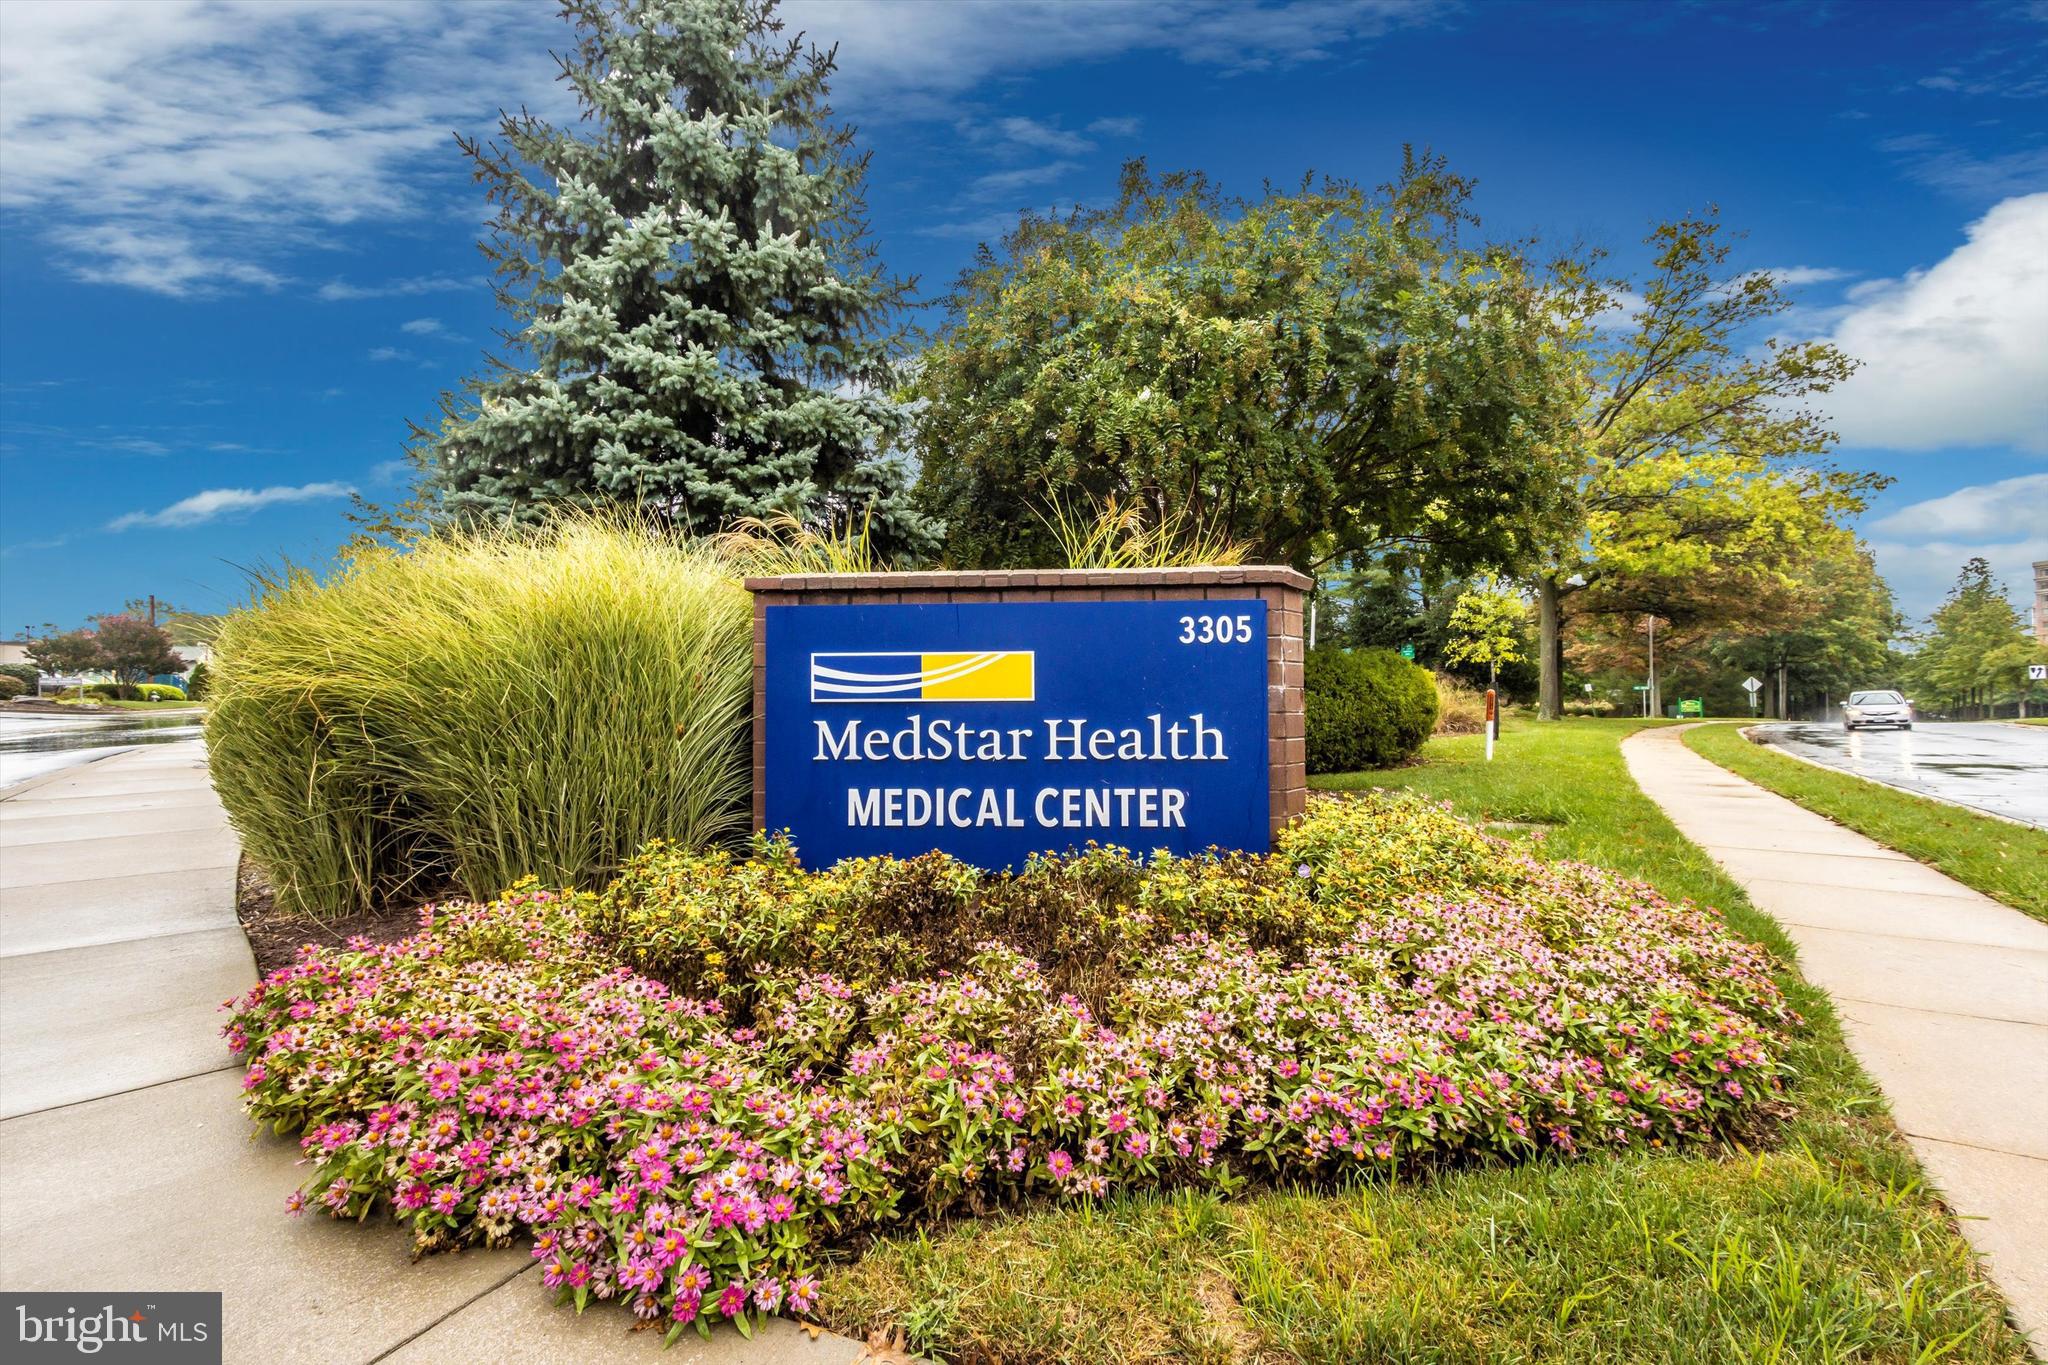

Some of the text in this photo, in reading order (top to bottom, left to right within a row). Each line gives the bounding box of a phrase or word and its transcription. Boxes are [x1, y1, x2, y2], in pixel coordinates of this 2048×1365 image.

[1179, 615, 1252, 644] 3305
[813, 713, 1229, 761] MedStar Health
[847, 788, 1187, 828] MEDICAL CENTER
